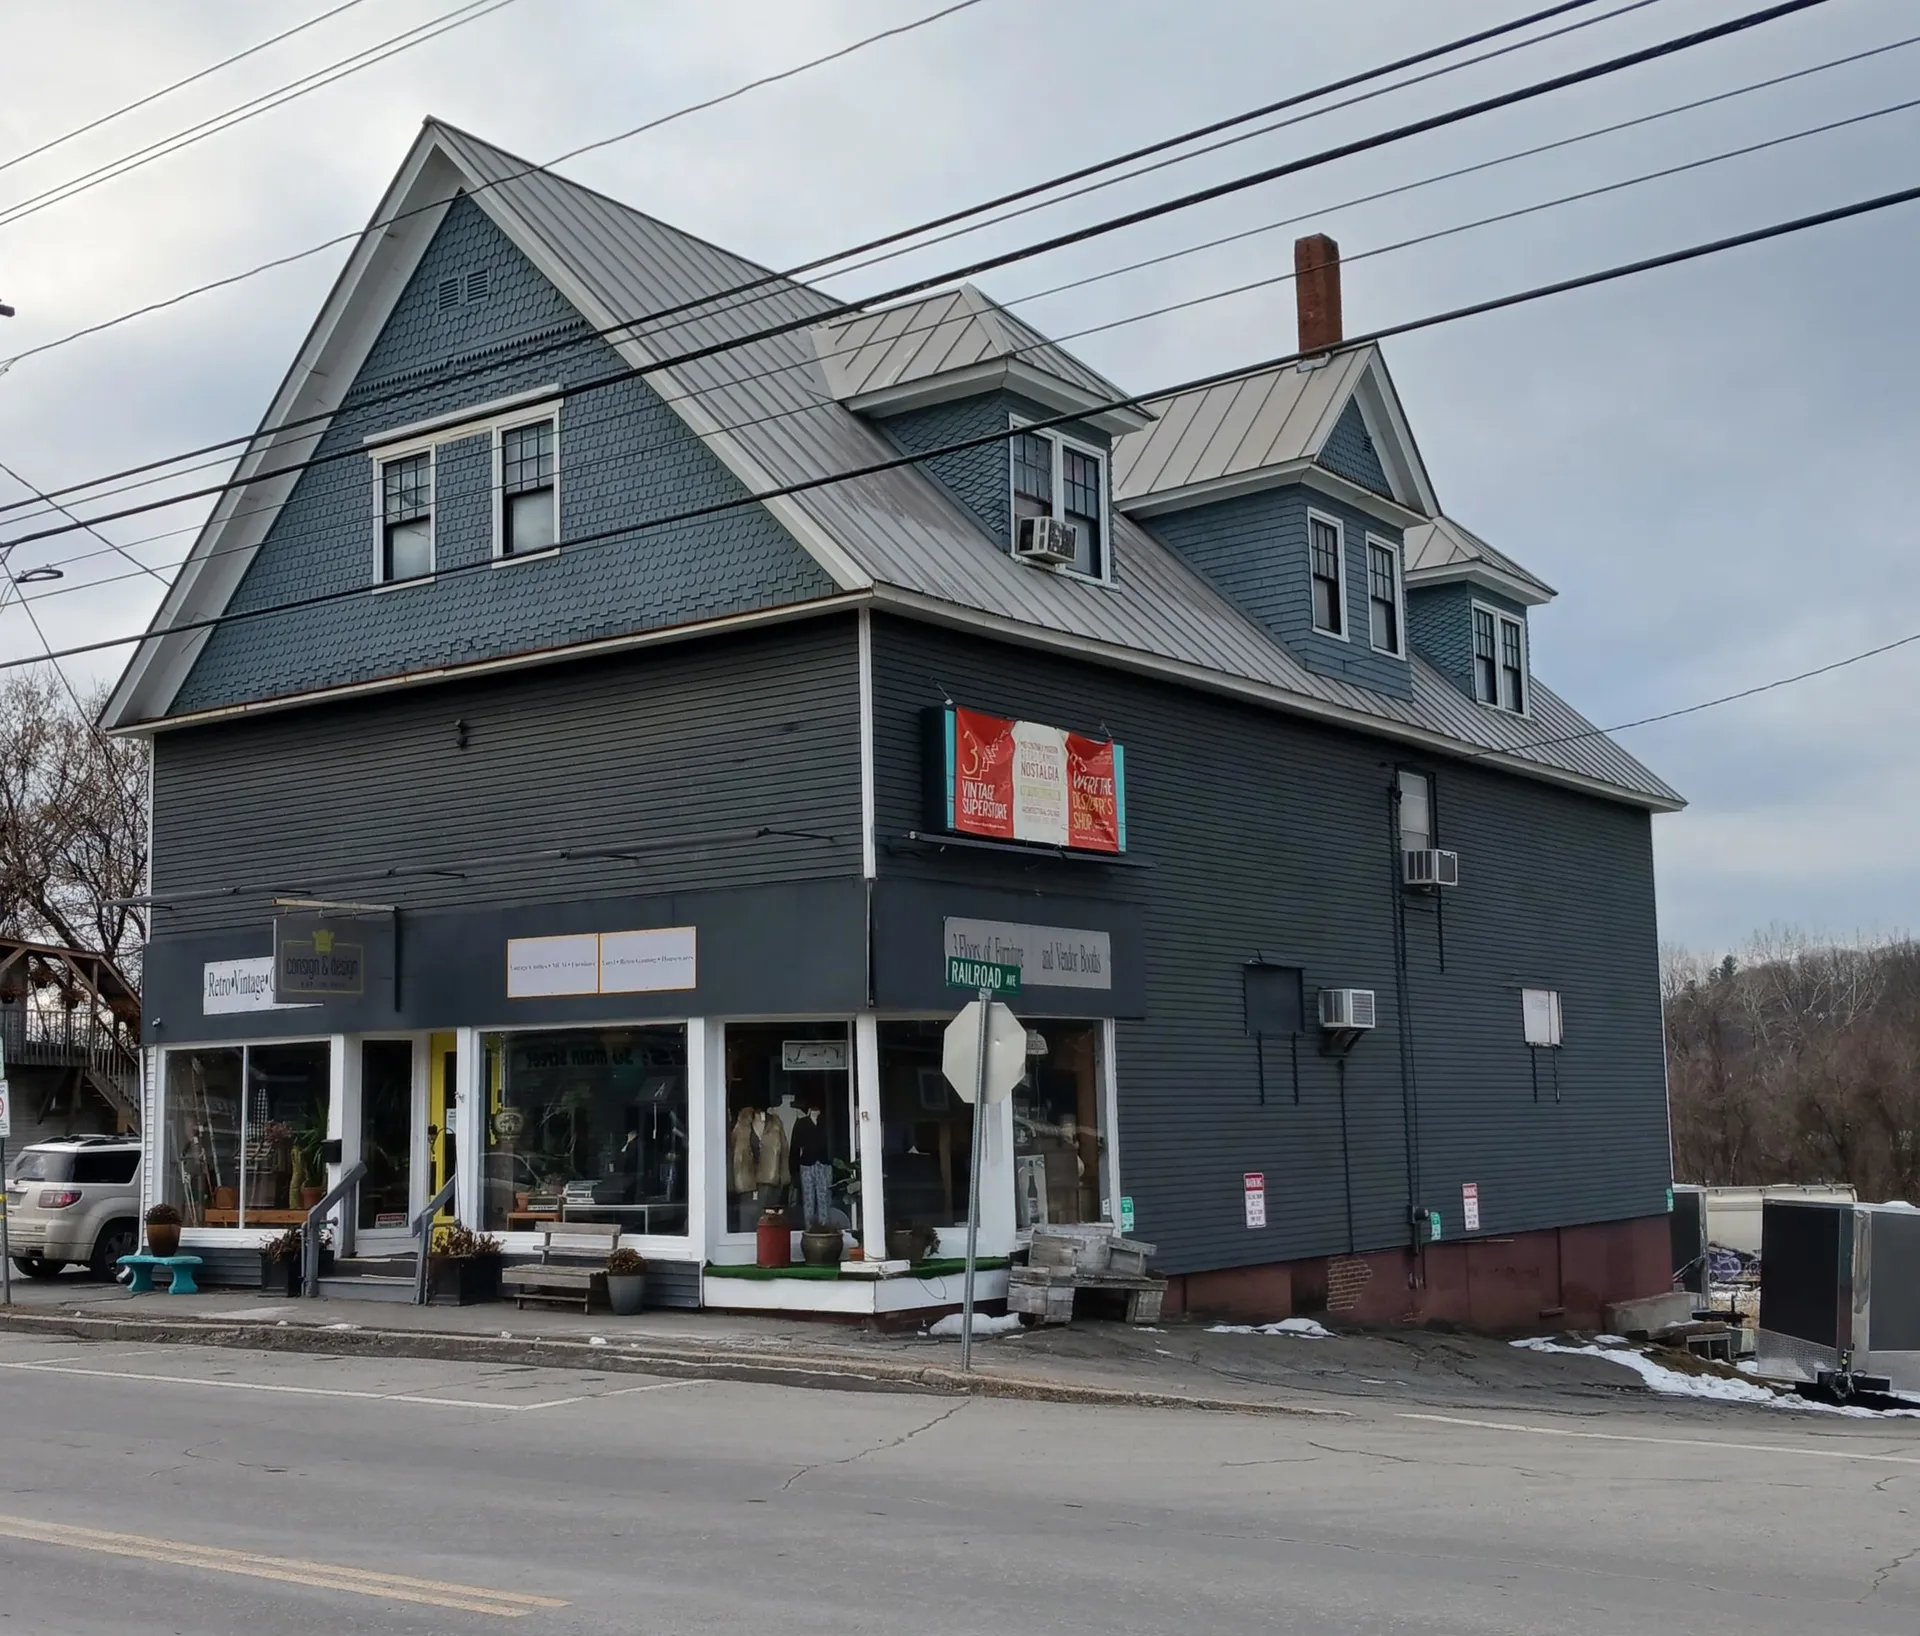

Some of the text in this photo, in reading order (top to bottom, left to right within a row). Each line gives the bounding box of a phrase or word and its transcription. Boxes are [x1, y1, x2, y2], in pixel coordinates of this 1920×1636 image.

[962, 730, 979, 775] 3
[1020, 761, 1060, 782] NOSTALGIA
[962, 798, 1008, 820] SUPERSTORE
[984, 936, 992, 962] of
[995, 937, 1024, 968] Furniture
[1042, 942, 1053, 969] and
[1056, 943, 1078, 972] Vendor
[286, 955, 359, 980] consign & design
[951, 960, 1017, 989] RAILROAD AVE
